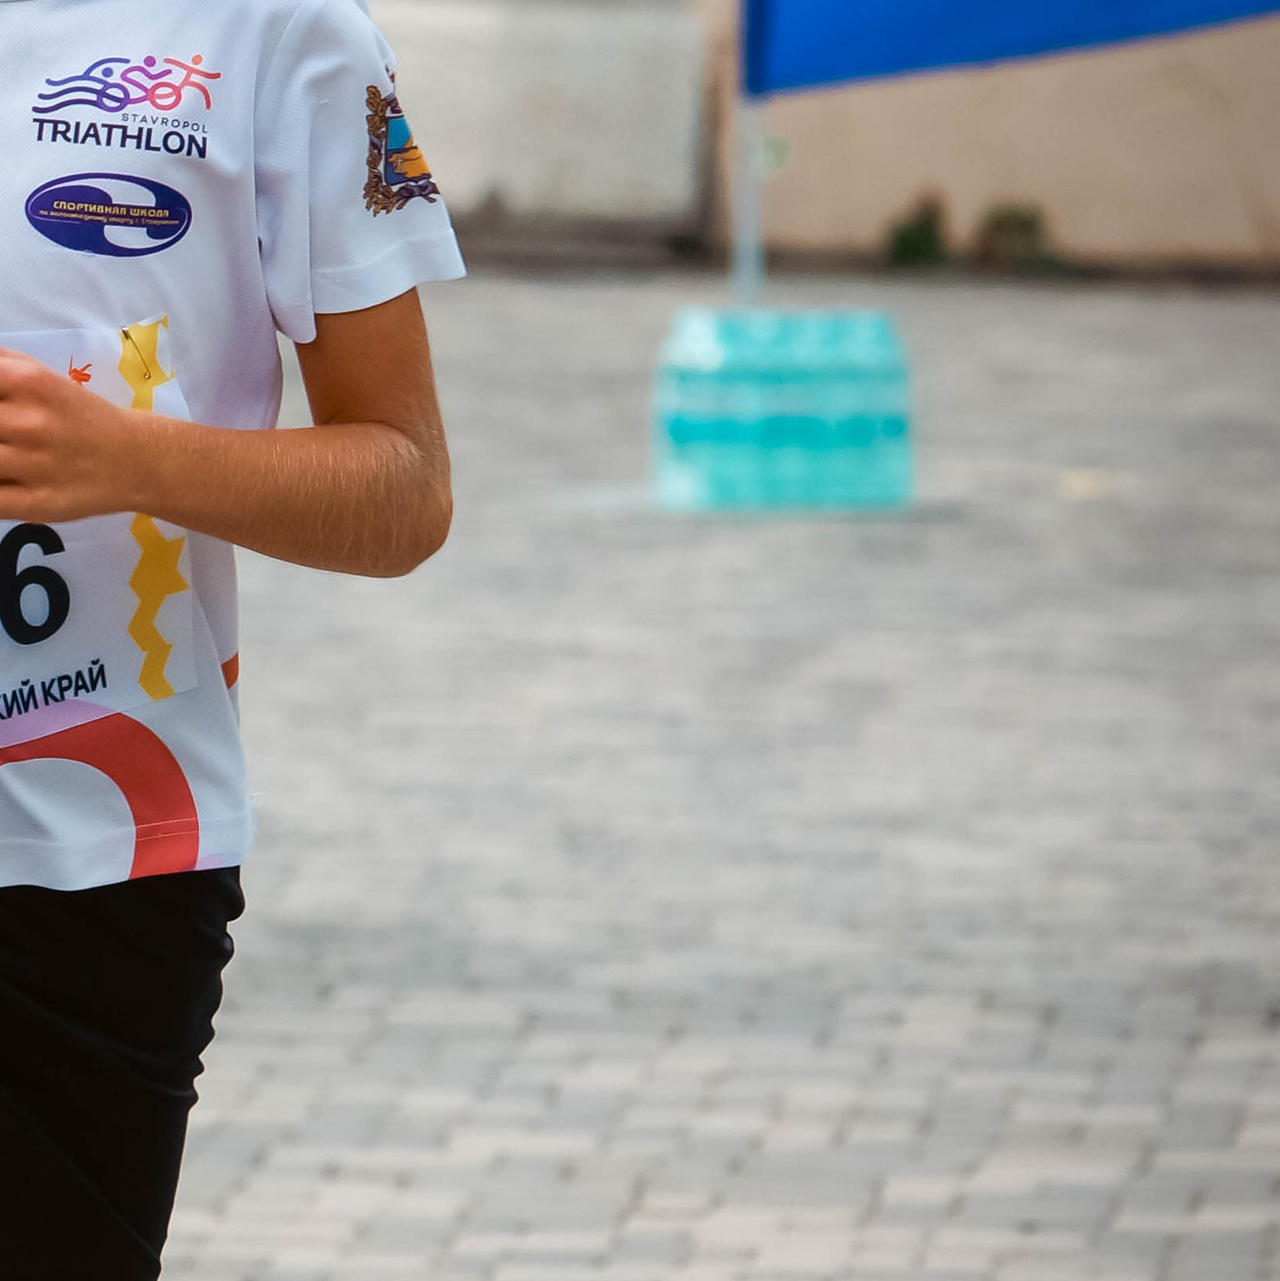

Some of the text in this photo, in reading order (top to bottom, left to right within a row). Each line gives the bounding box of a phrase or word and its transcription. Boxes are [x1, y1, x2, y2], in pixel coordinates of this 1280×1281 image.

[32, 118, 208, 159] TRIATHLON
[121, 112, 208, 134] STAVROPOL
[53, 200, 127, 215] СПОРТИВНАЯ
[129, 207, 170, 218] ШКОЛА
[41, 659, 108, 705] КРАЙ
